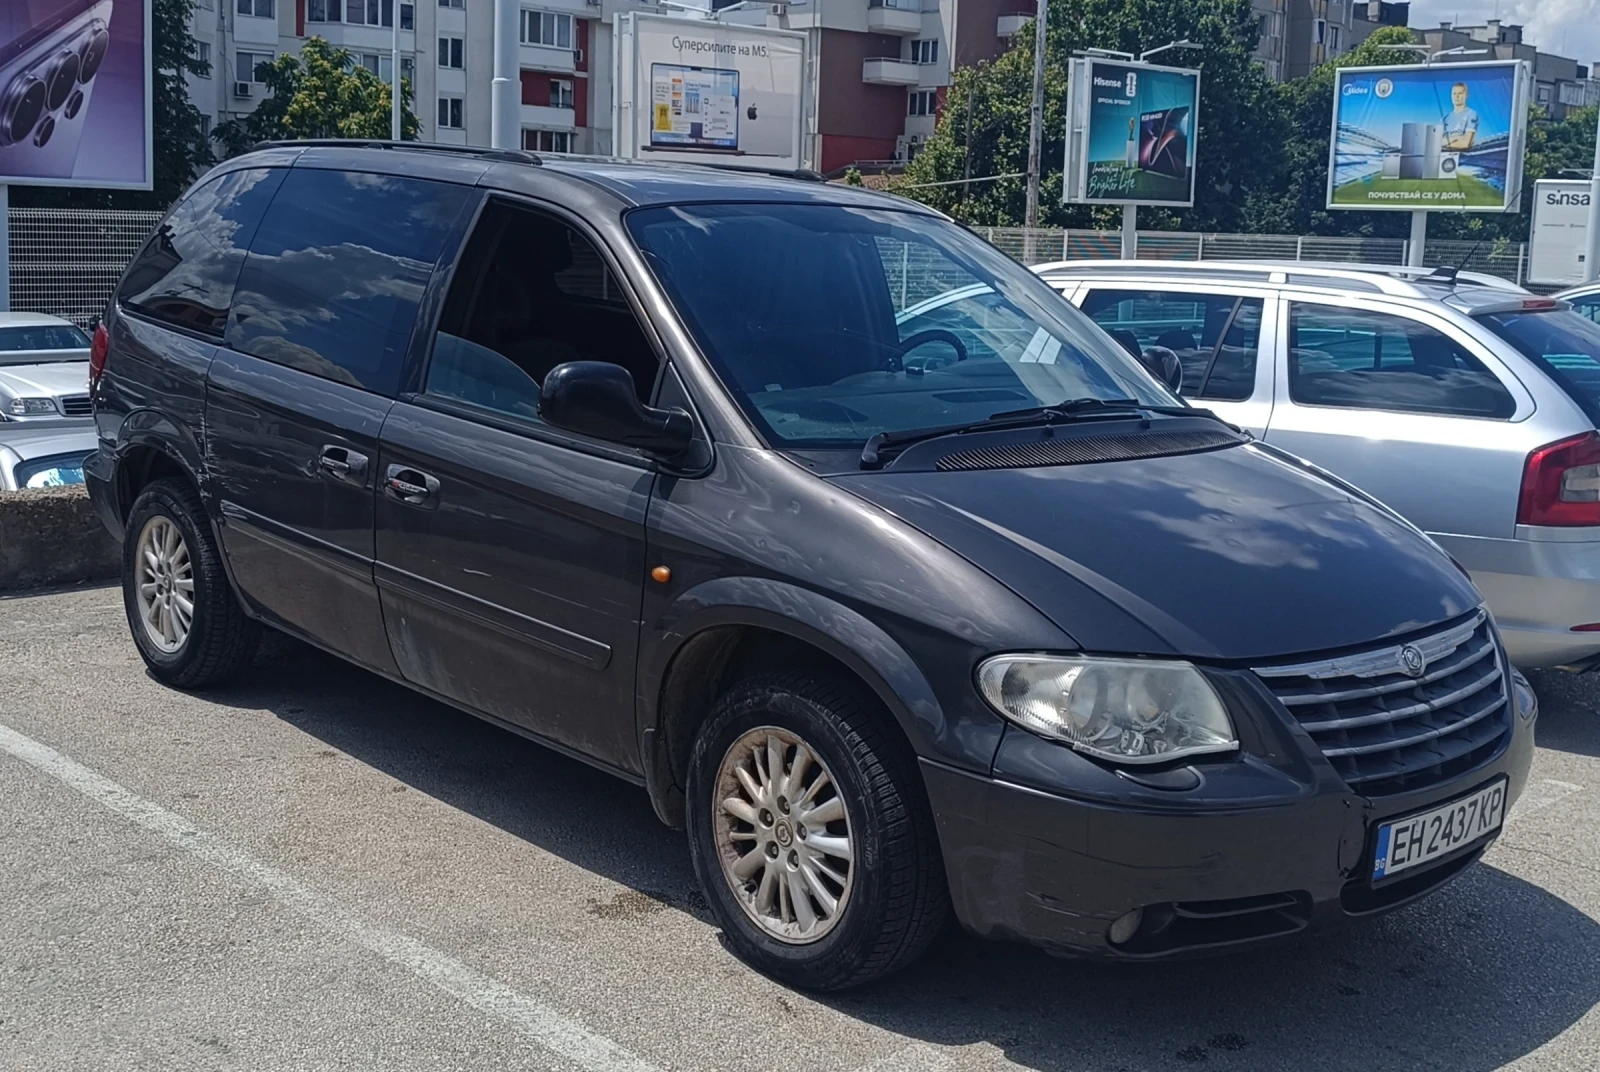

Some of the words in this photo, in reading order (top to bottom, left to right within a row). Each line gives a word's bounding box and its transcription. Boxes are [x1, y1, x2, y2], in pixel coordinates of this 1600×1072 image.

[672, 36, 737, 54] Суперсилите
[738, 45, 750, 56] на
[1094, 76, 1122, 88] Hisense
[1087, 175, 1118, 198] Brighter
[1118, 169, 1137, 195] Life
[1368, 190, 1420, 199] ПОЧУВСТВАЙ
[1421, 191, 1433, 199] СЕ
[1433, 191, 1440, 199] У
[1440, 191, 1466, 200] ДОМА
